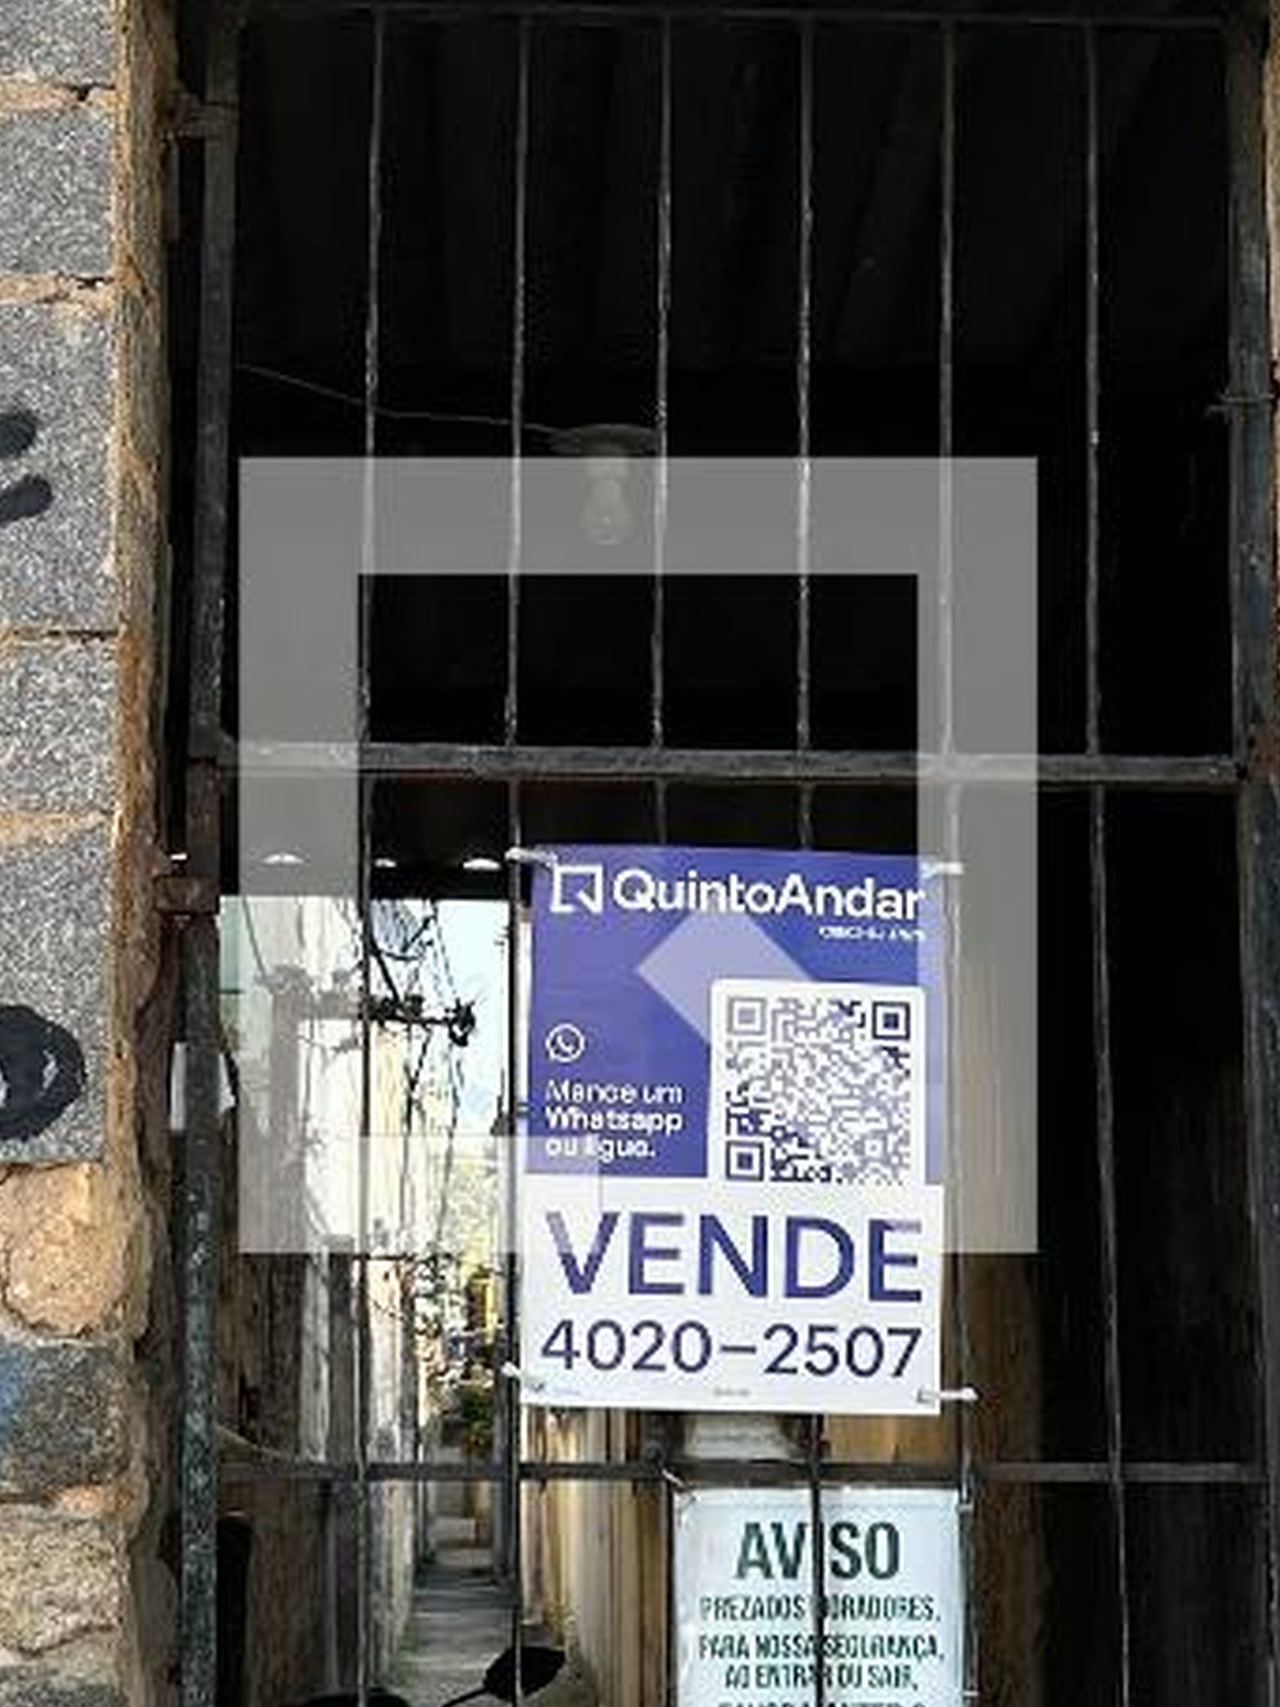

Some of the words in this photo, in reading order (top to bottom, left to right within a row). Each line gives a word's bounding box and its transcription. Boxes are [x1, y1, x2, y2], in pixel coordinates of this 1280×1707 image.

[612, 868, 924, 921] QuintoAndar
[544, 1210, 922, 1303] VENDE
[541, 1318, 922, 1378] 4020-2507
[735, 1522, 900, 1579] AVSO
[700, 1595, 806, 1621] PREZADOS
[699, 1635, 749, 1659] PARA
[725, 1665, 749, 1688] AO
[838, 1665, 863, 1688] OU
